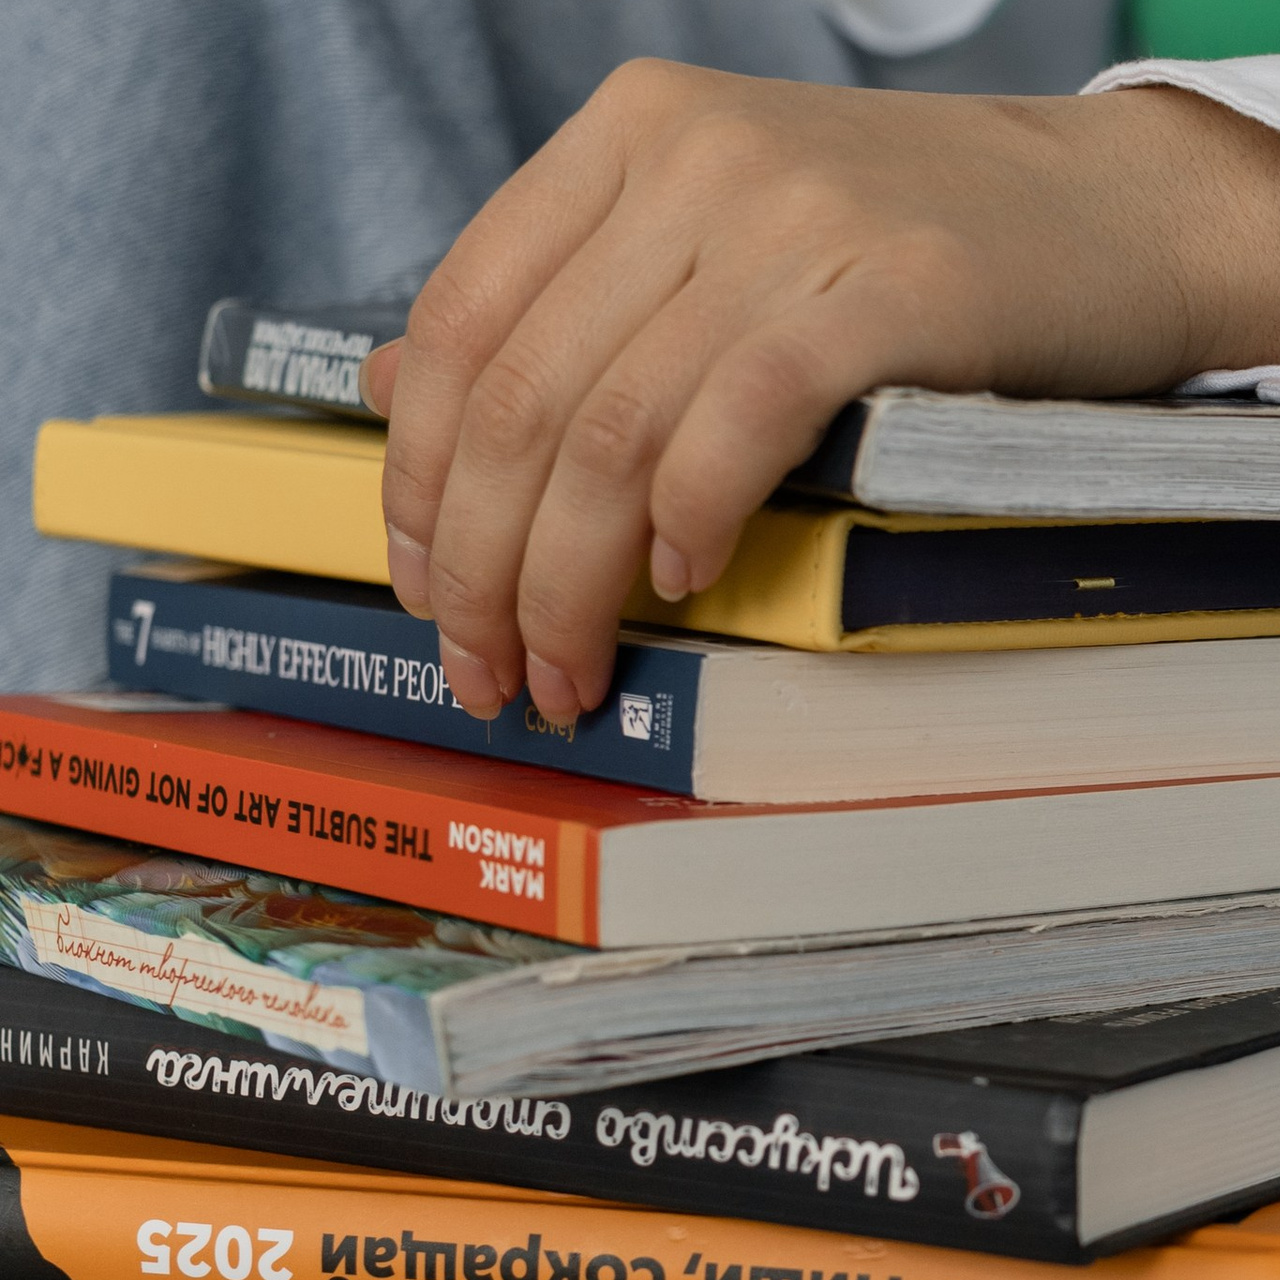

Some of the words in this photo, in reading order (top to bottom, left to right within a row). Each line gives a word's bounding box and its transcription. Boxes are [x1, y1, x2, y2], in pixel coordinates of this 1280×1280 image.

[131, 599, 156, 666] 7
[202, 624, 276, 675] HIGHLY
[278, 636, 388, 696] EFFECTIVE
[393, 657, 464, 710] PEOP
[49, 749, 64, 780] A
[69, 754, 140, 798] GIVING
[145, 771, 191, 810] NOT
[196, 783, 228, 817] OF
[233, 790, 281, 828] ART
[287, 800, 376, 850] SUBTLE
[384, 820, 433, 862] THE
[448, 820, 545, 867] MANSON
[479, 859, 545, 901] MARK
[139, 942, 259, 1007] творческого
[261, 982, 349, 1028] человека
[1, 1027, 109, 1076] КАРМИН
[145, 1048, 571, 1140] сторителлинга
[596, 1106, 919, 1202] Искусство
